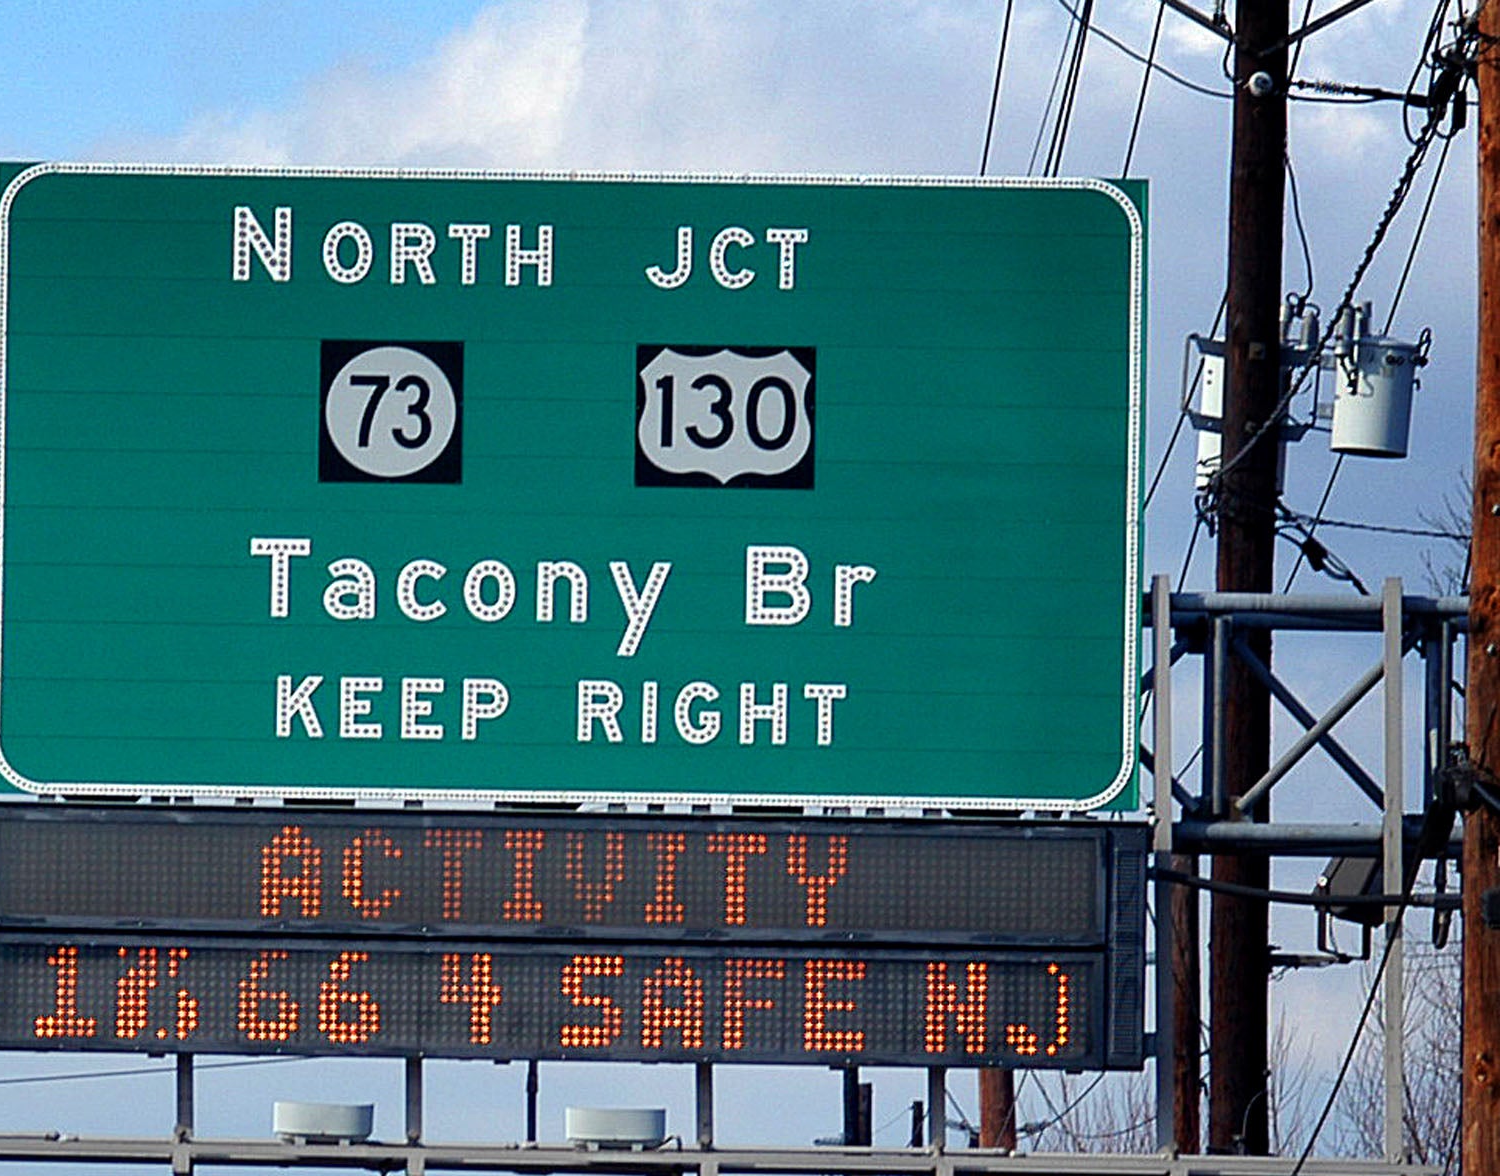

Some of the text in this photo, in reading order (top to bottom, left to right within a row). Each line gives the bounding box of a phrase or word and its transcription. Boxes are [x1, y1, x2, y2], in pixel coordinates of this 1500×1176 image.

[231, 204, 812, 292] NORTH JCT
[348, 373, 434, 452] 73
[654, 373, 799, 452] 130
[248, 536, 879, 658] Tacony Br
[274, 673, 849, 747] KEEP RIGHT
[258, 824, 850, 929] ACTIVITY
[559, 953, 868, 1054] SAFE
